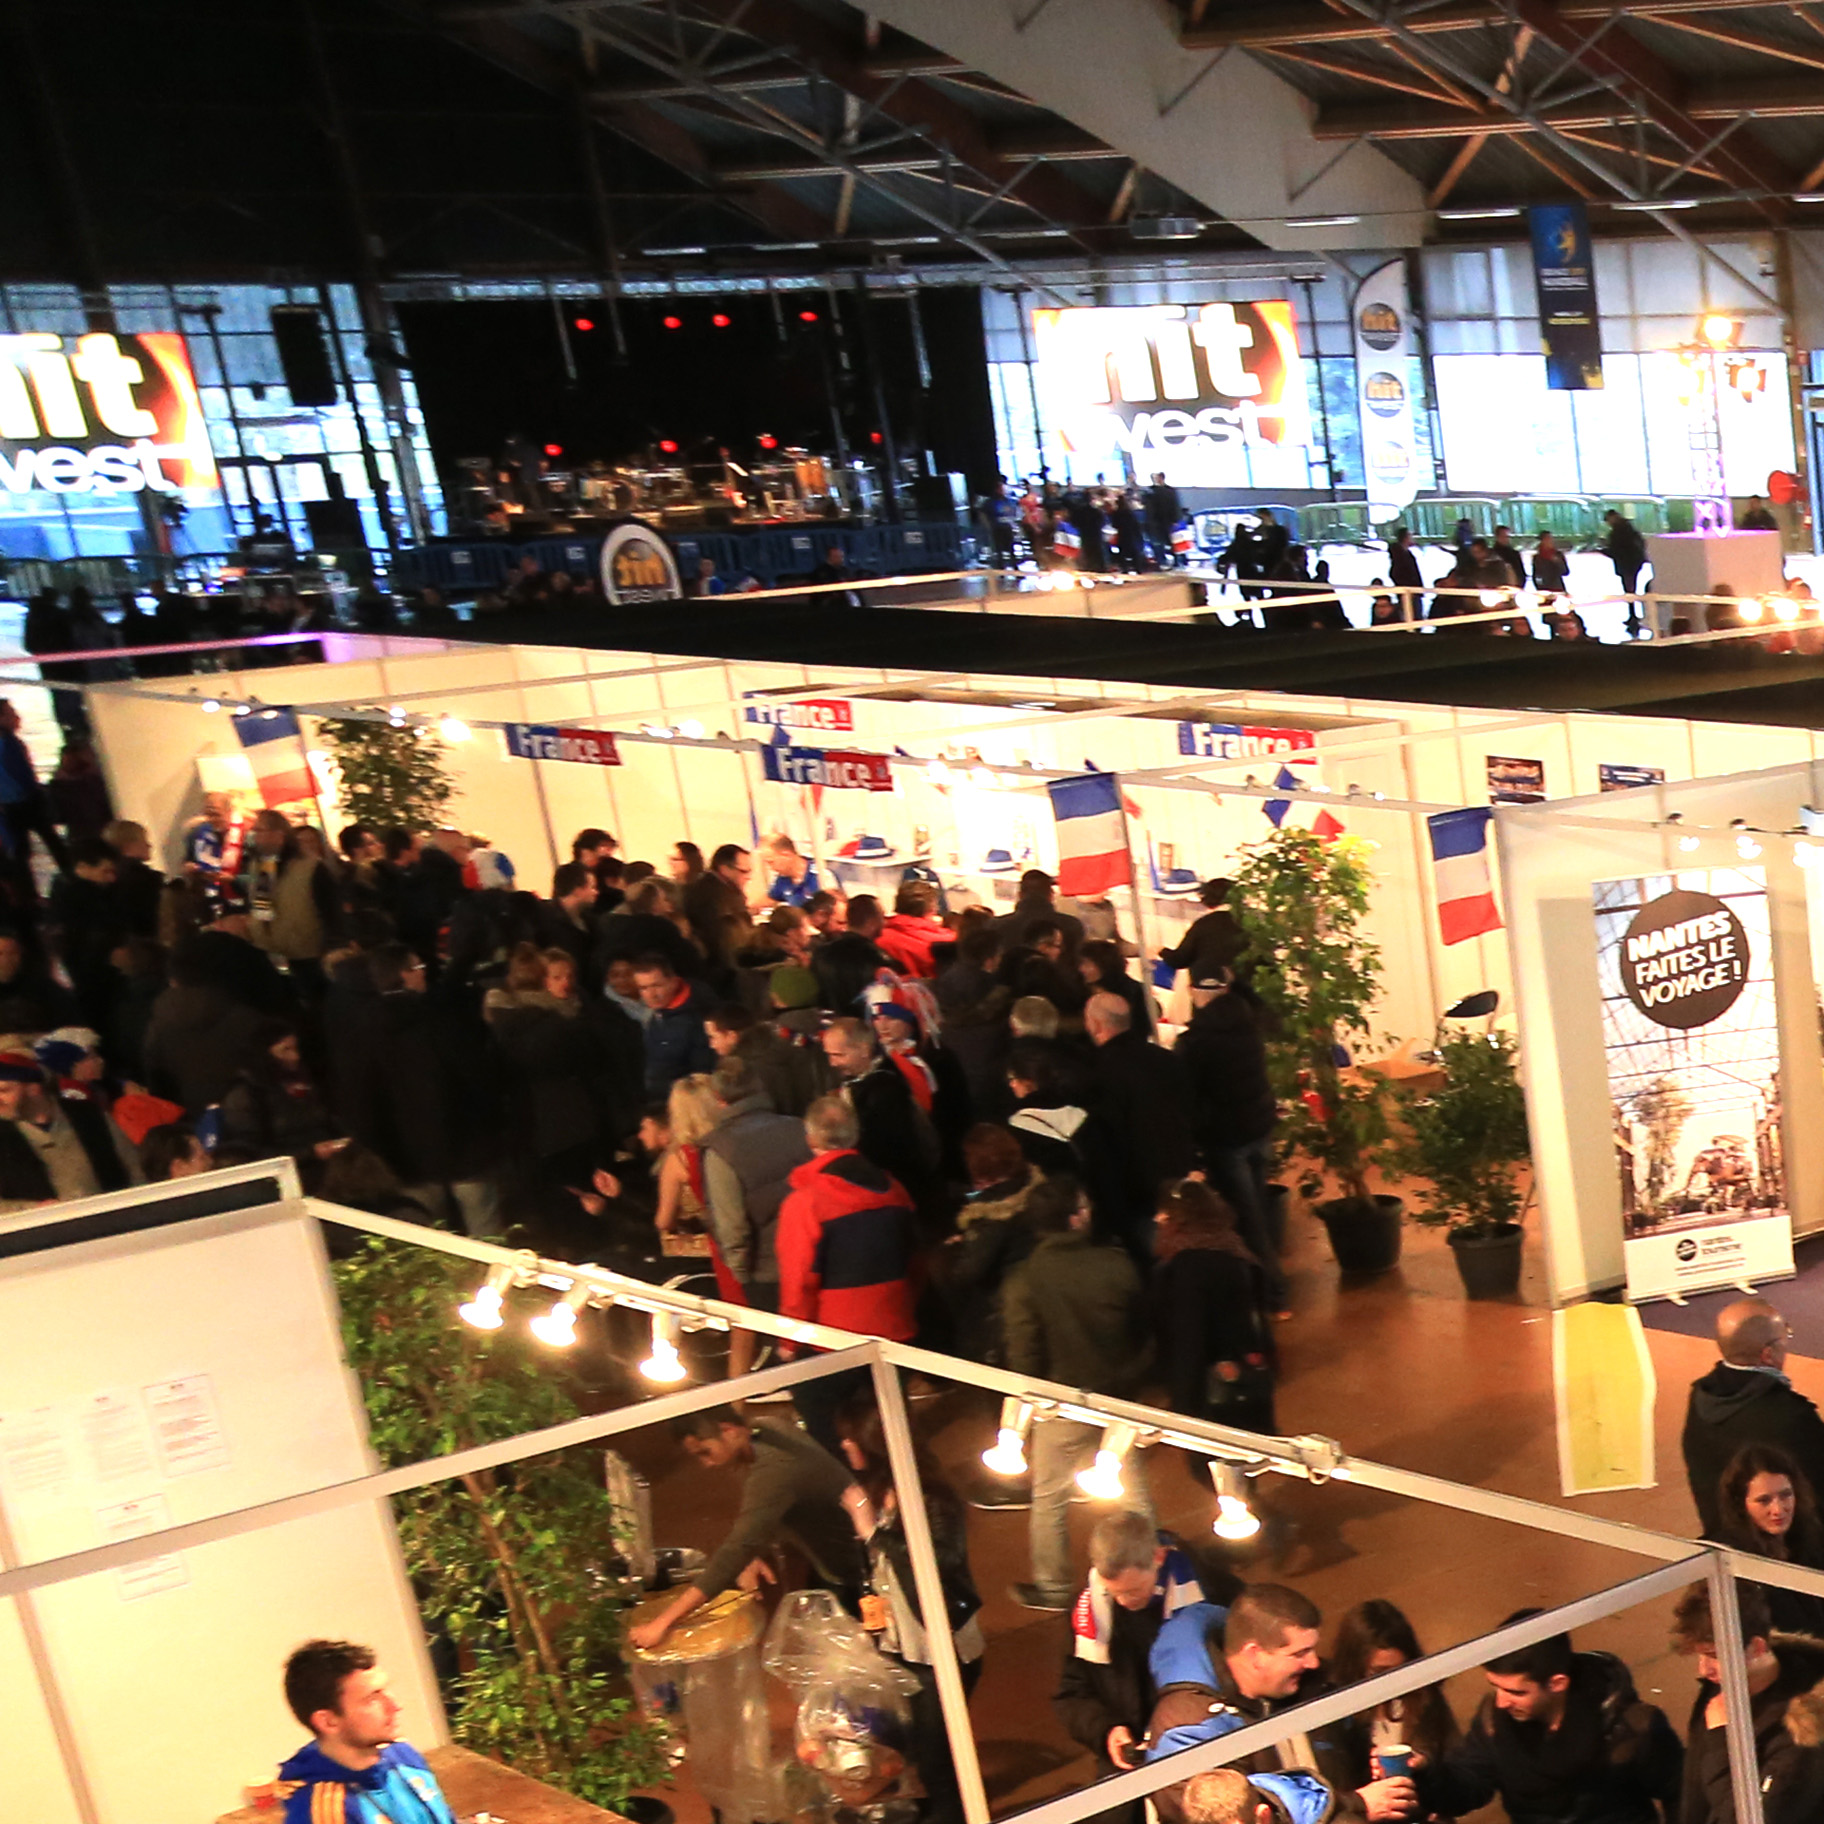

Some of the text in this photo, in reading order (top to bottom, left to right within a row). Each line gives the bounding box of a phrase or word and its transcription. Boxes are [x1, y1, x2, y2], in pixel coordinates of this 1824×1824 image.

[757, 703, 837, 729] France
[515, 725, 603, 763] France
[1192, 723, 1292, 759] France
[776, 747, 875, 788] France
[1627, 910, 1732, 962] NANTES
[1635, 936, 1737, 985] FAITES LE
[1638, 963, 1731, 1008] VOYAGE
